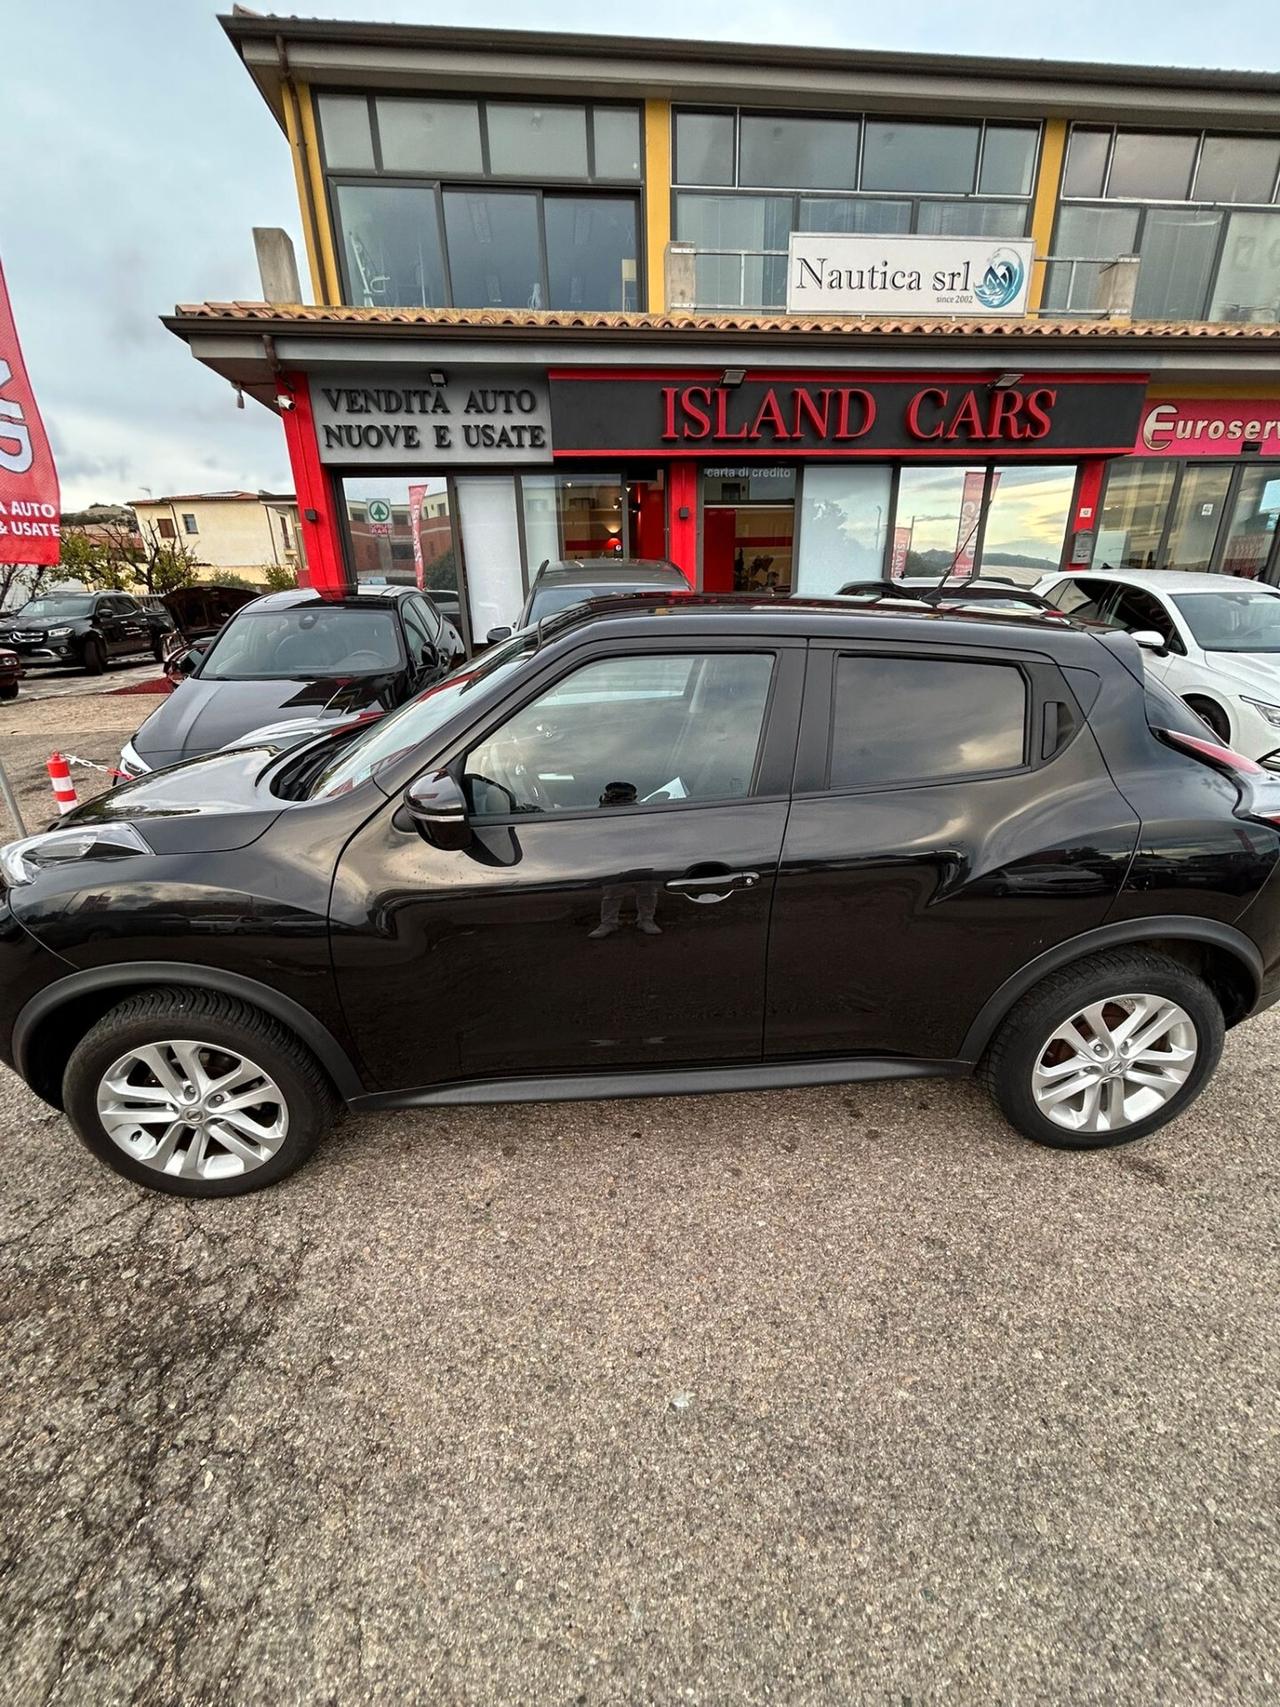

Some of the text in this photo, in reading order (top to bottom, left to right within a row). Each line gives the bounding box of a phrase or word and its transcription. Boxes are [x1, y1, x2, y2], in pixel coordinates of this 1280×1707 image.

[796, 257, 971, 291] Nautica srl
[936, 295, 973, 304] since 2002
[464, 389, 537, 414] AUTO
[661, 386, 1057, 441] ISLAND CARS
[322, 424, 546, 449] NUOVE E USATE
[707, 466, 791, 478] carta di credito
[11, 500, 56, 518] AUTO
[10, 521, 61, 537] USATE
